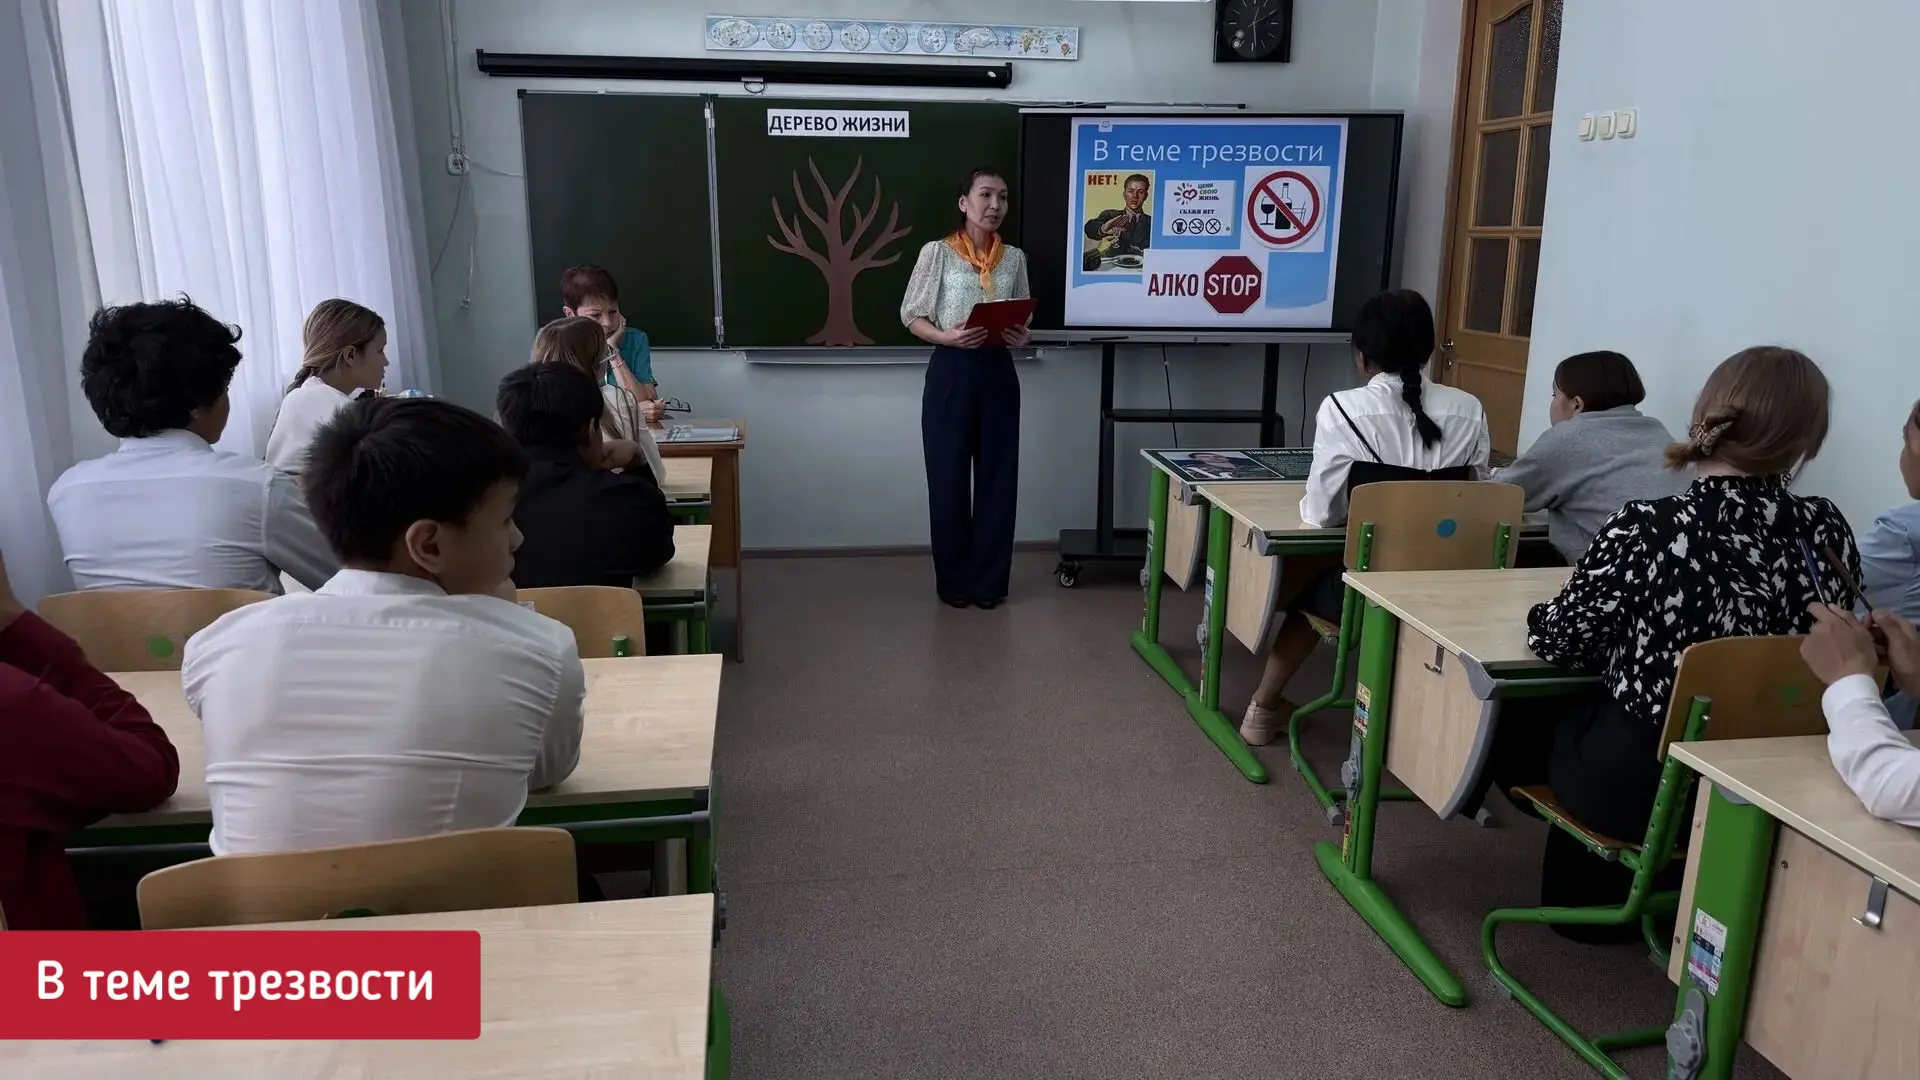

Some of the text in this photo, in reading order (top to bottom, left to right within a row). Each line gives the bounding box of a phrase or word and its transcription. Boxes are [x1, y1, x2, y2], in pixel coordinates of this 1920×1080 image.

[769, 115, 905, 134] ДЕРЕВО ЖИЗНИ
[1093, 139, 1324, 168] В теме трезвости
[1087, 173, 1118, 186] НЕТ!
[1147, 273, 1260, 297] АЛКО STOP
